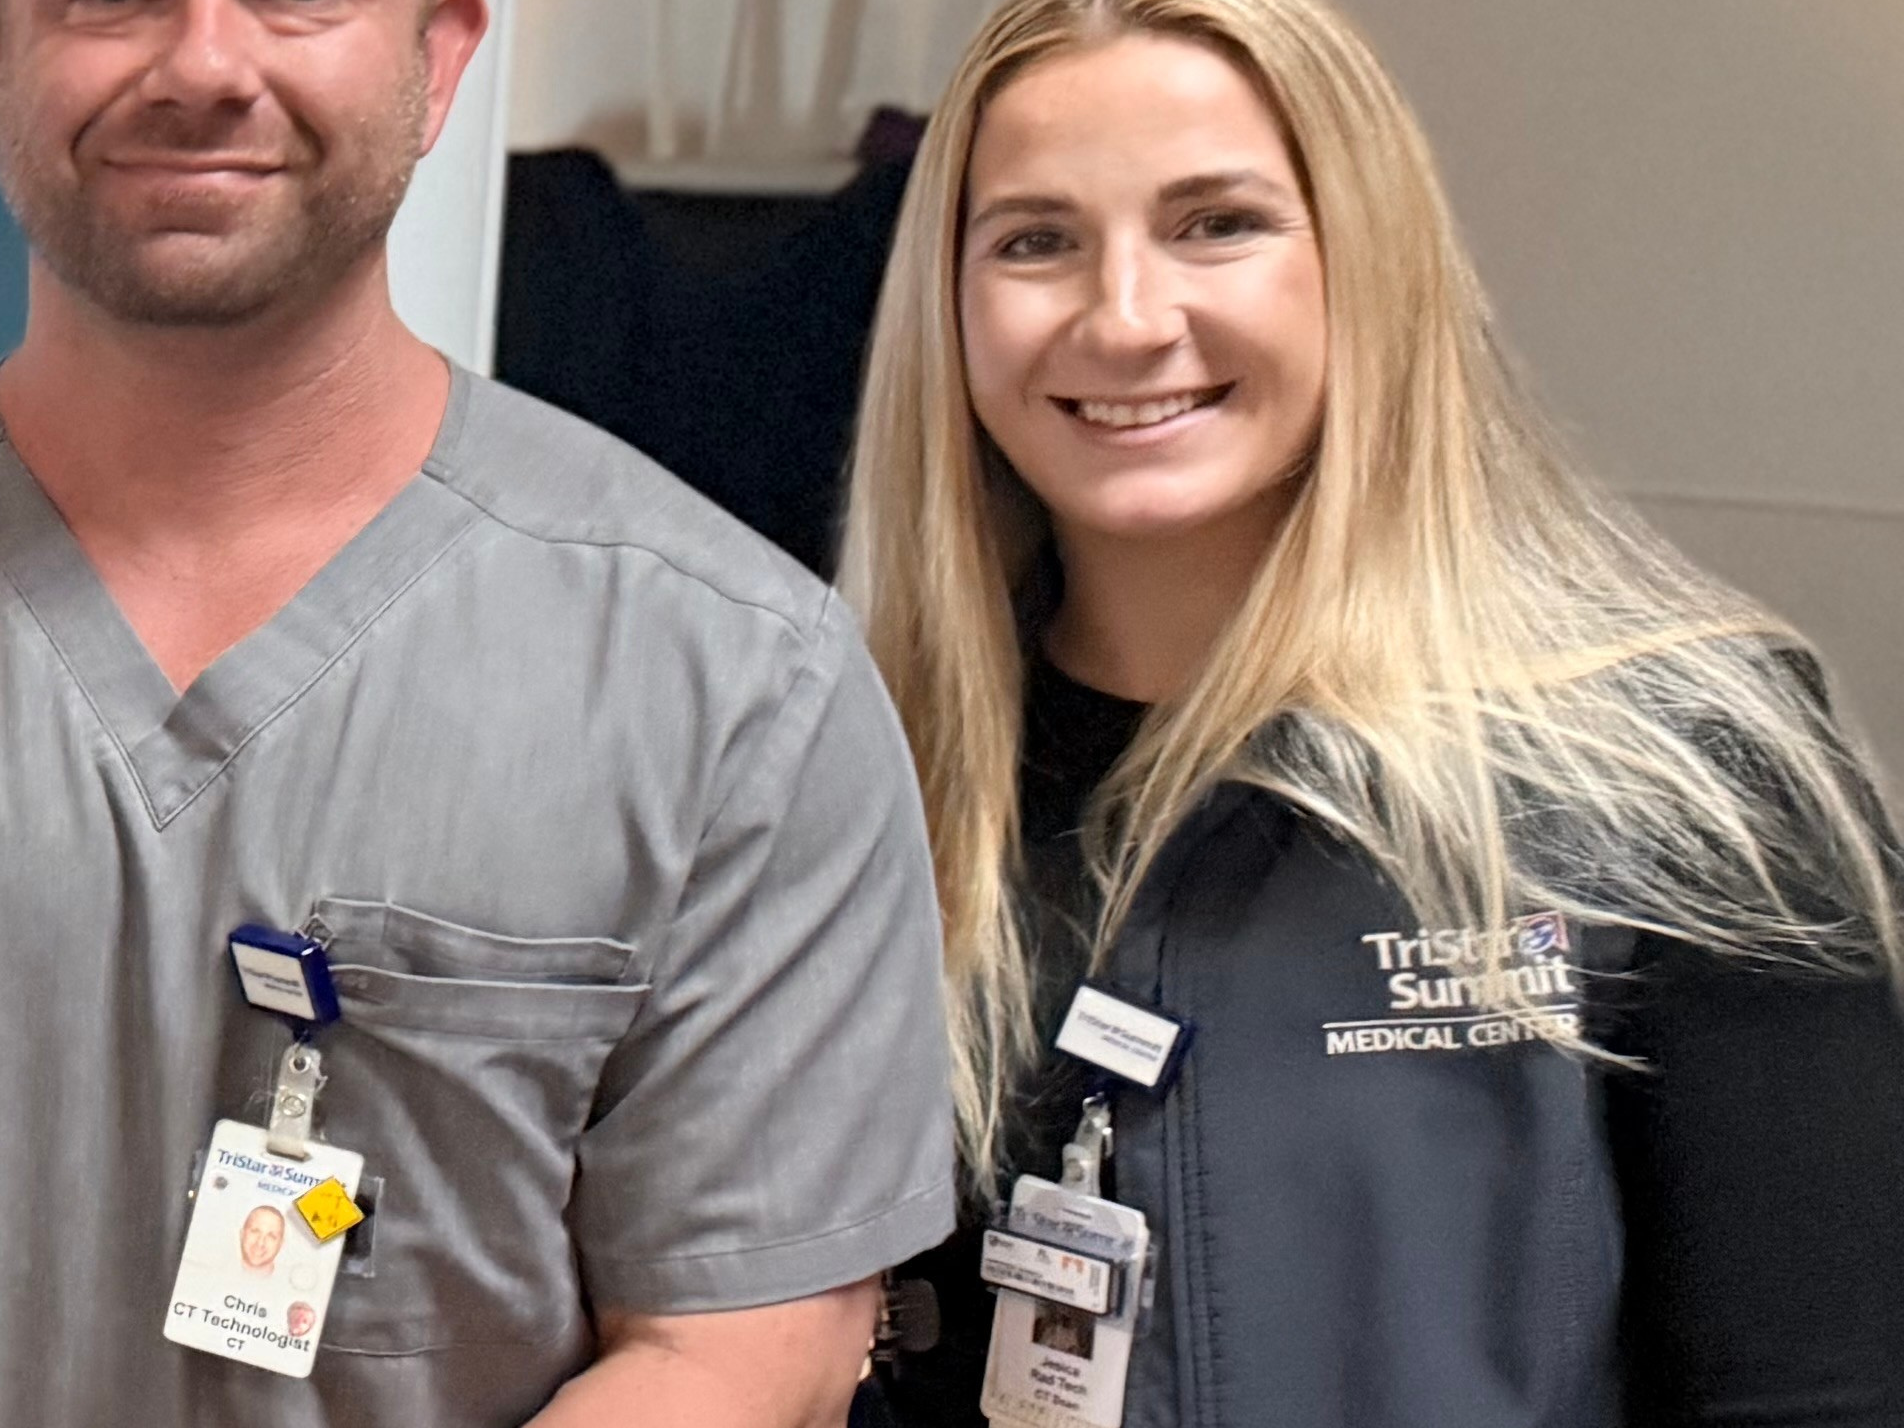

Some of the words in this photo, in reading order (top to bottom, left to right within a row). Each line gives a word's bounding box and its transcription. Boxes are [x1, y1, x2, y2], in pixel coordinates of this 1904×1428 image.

[1361, 928, 1516, 970] TriStr
[1326, 1026, 1462, 1055] MEDICAL
[218, 1148, 269, 1174] TriStar
[223, 1294, 268, 1319] Chris
[173, 1301, 198, 1319] CT
[202, 1308, 310, 1353] Technologist
[226, 1337, 246, 1351] CT
